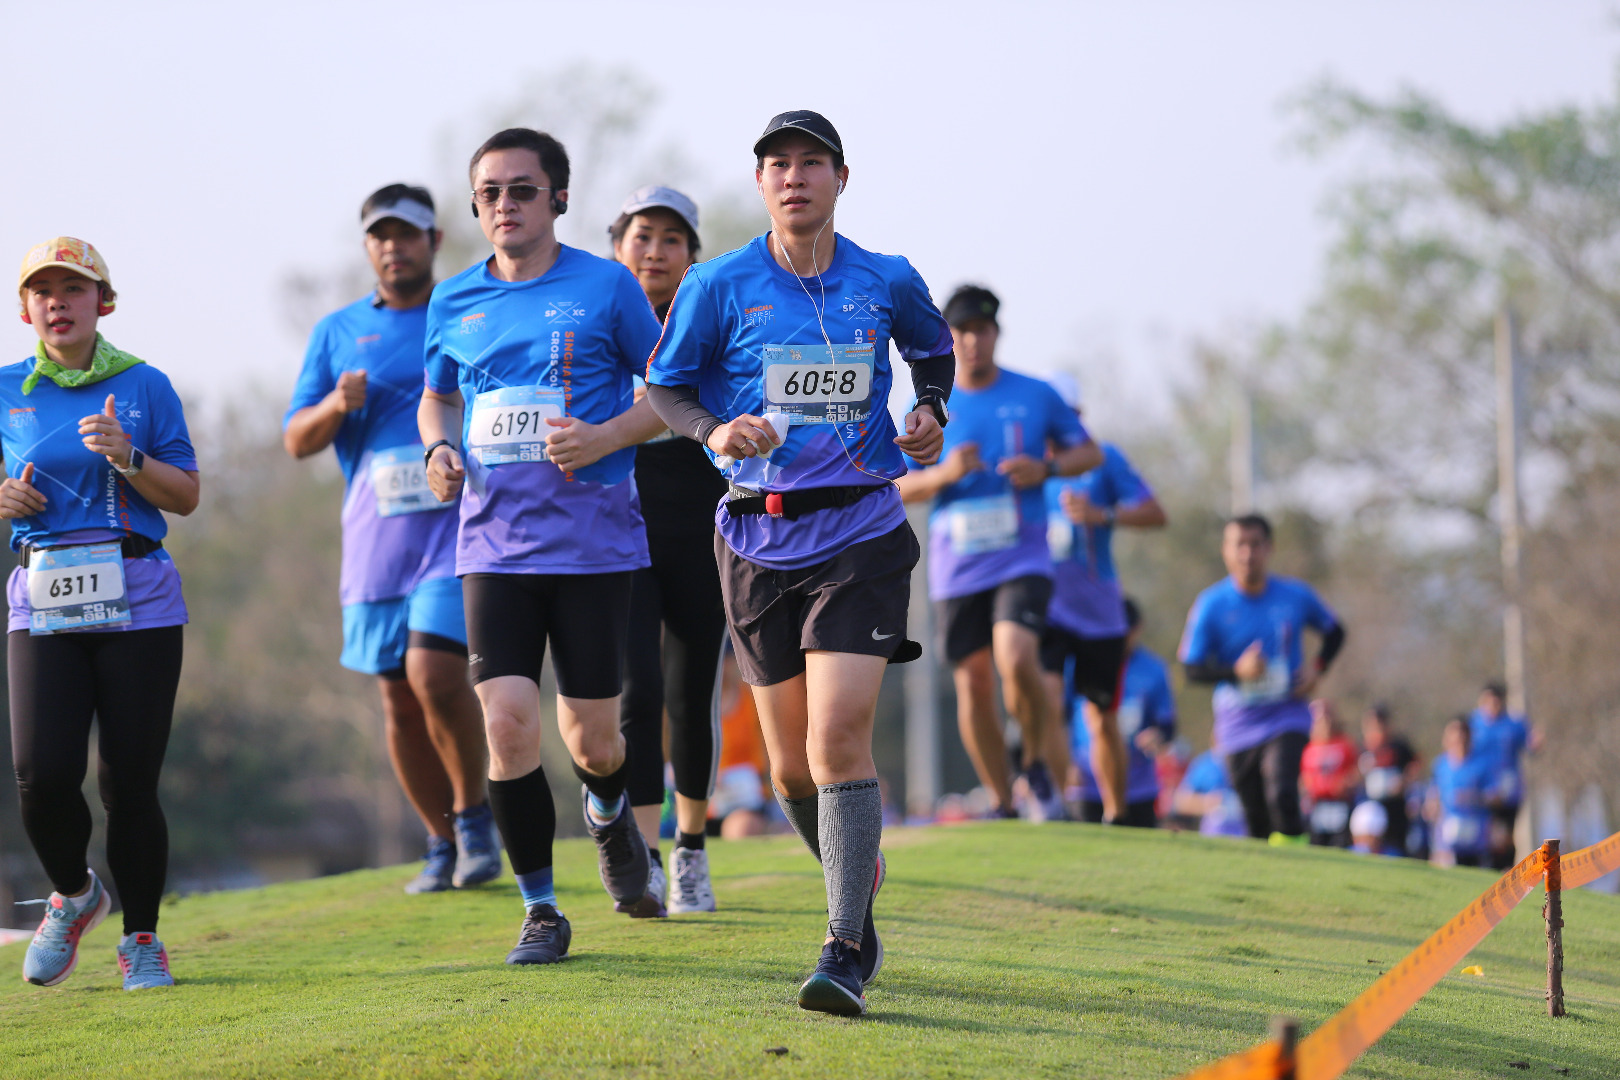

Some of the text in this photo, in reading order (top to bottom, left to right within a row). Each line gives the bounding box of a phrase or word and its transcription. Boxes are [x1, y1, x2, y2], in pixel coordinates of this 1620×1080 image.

[544, 309, 586, 318] SP XC
[842, 304, 880, 312] SP XC
[550, 331, 560, 367] CROSS
[562, 331, 575, 377] SINGHA
[784, 370, 857, 396] 6058
[128, 410, 142, 418] XC
[491, 411, 540, 437] 6191
[846, 423, 856, 439] UN
[390, 466, 427, 491] 616
[106, 468, 116, 518] COUNTRY
[49, 573, 98, 598] 6311
[106, 607, 118, 619] 16
[822, 781, 879, 794] ZENSAH
